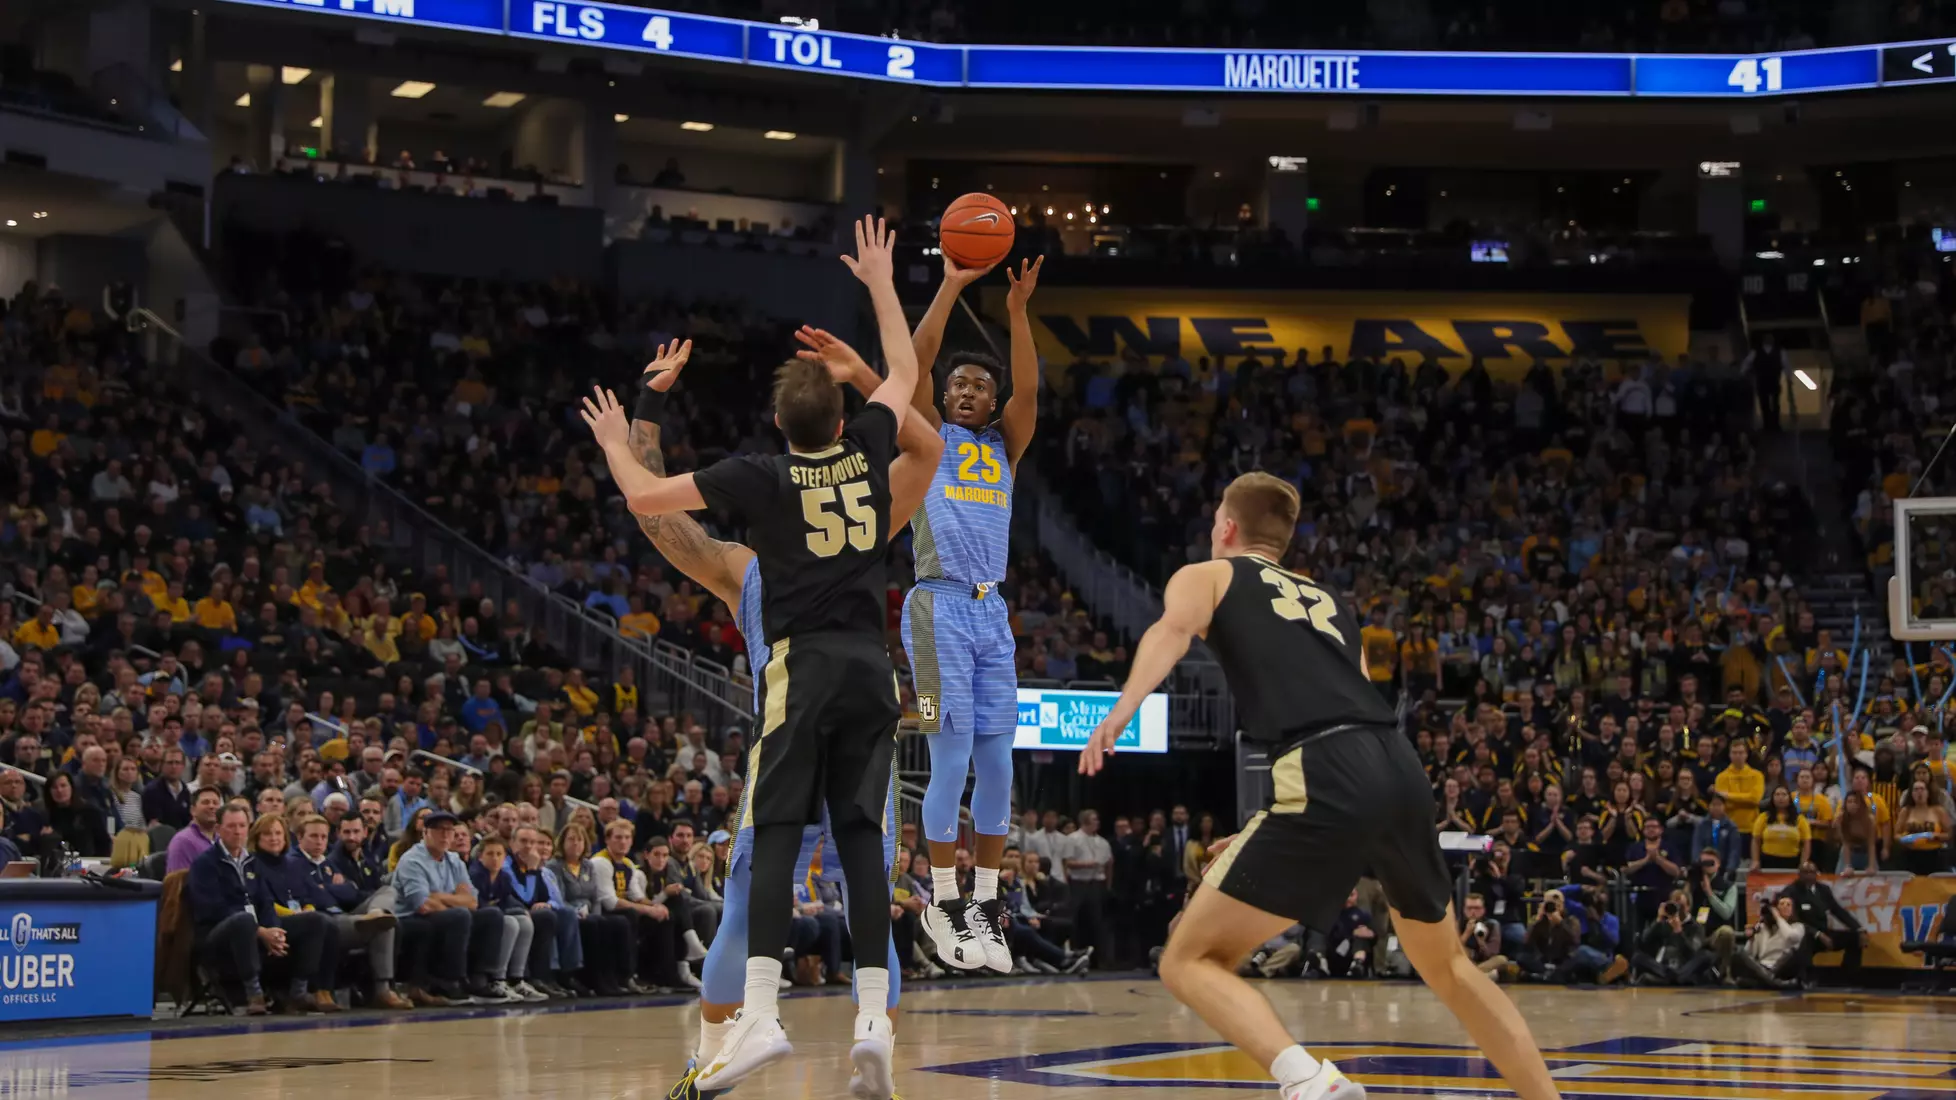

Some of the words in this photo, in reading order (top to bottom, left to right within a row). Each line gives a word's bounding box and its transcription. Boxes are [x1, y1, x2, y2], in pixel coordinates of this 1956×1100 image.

[533, 2, 605, 41] FLS
[642, 16, 674, 51] 4
[768, 31, 841, 70] TOL
[886, 45, 915, 80] 2
[1224, 54, 1360, 91] MARQUETTE
[1727, 57, 1783, 93] 41
[1039, 316, 1287, 357] WE
[1348, 319, 1652, 359] ARE
[789, 451, 869, 488] STEFANOVIC
[958, 442, 1001, 484] 25
[944, 485, 1008, 509] MARQUETTE
[800, 480, 877, 558] 55
[1259, 567, 1346, 646] 32
[918, 695, 940, 722] MU
[31, 927, 61, 940] THAT'S
[61, 927, 78, 940] ALL
[0, 954, 74, 990] UBER
[3, 993, 39, 1005] OFFICES
[41, 992, 57, 1003] LLC
